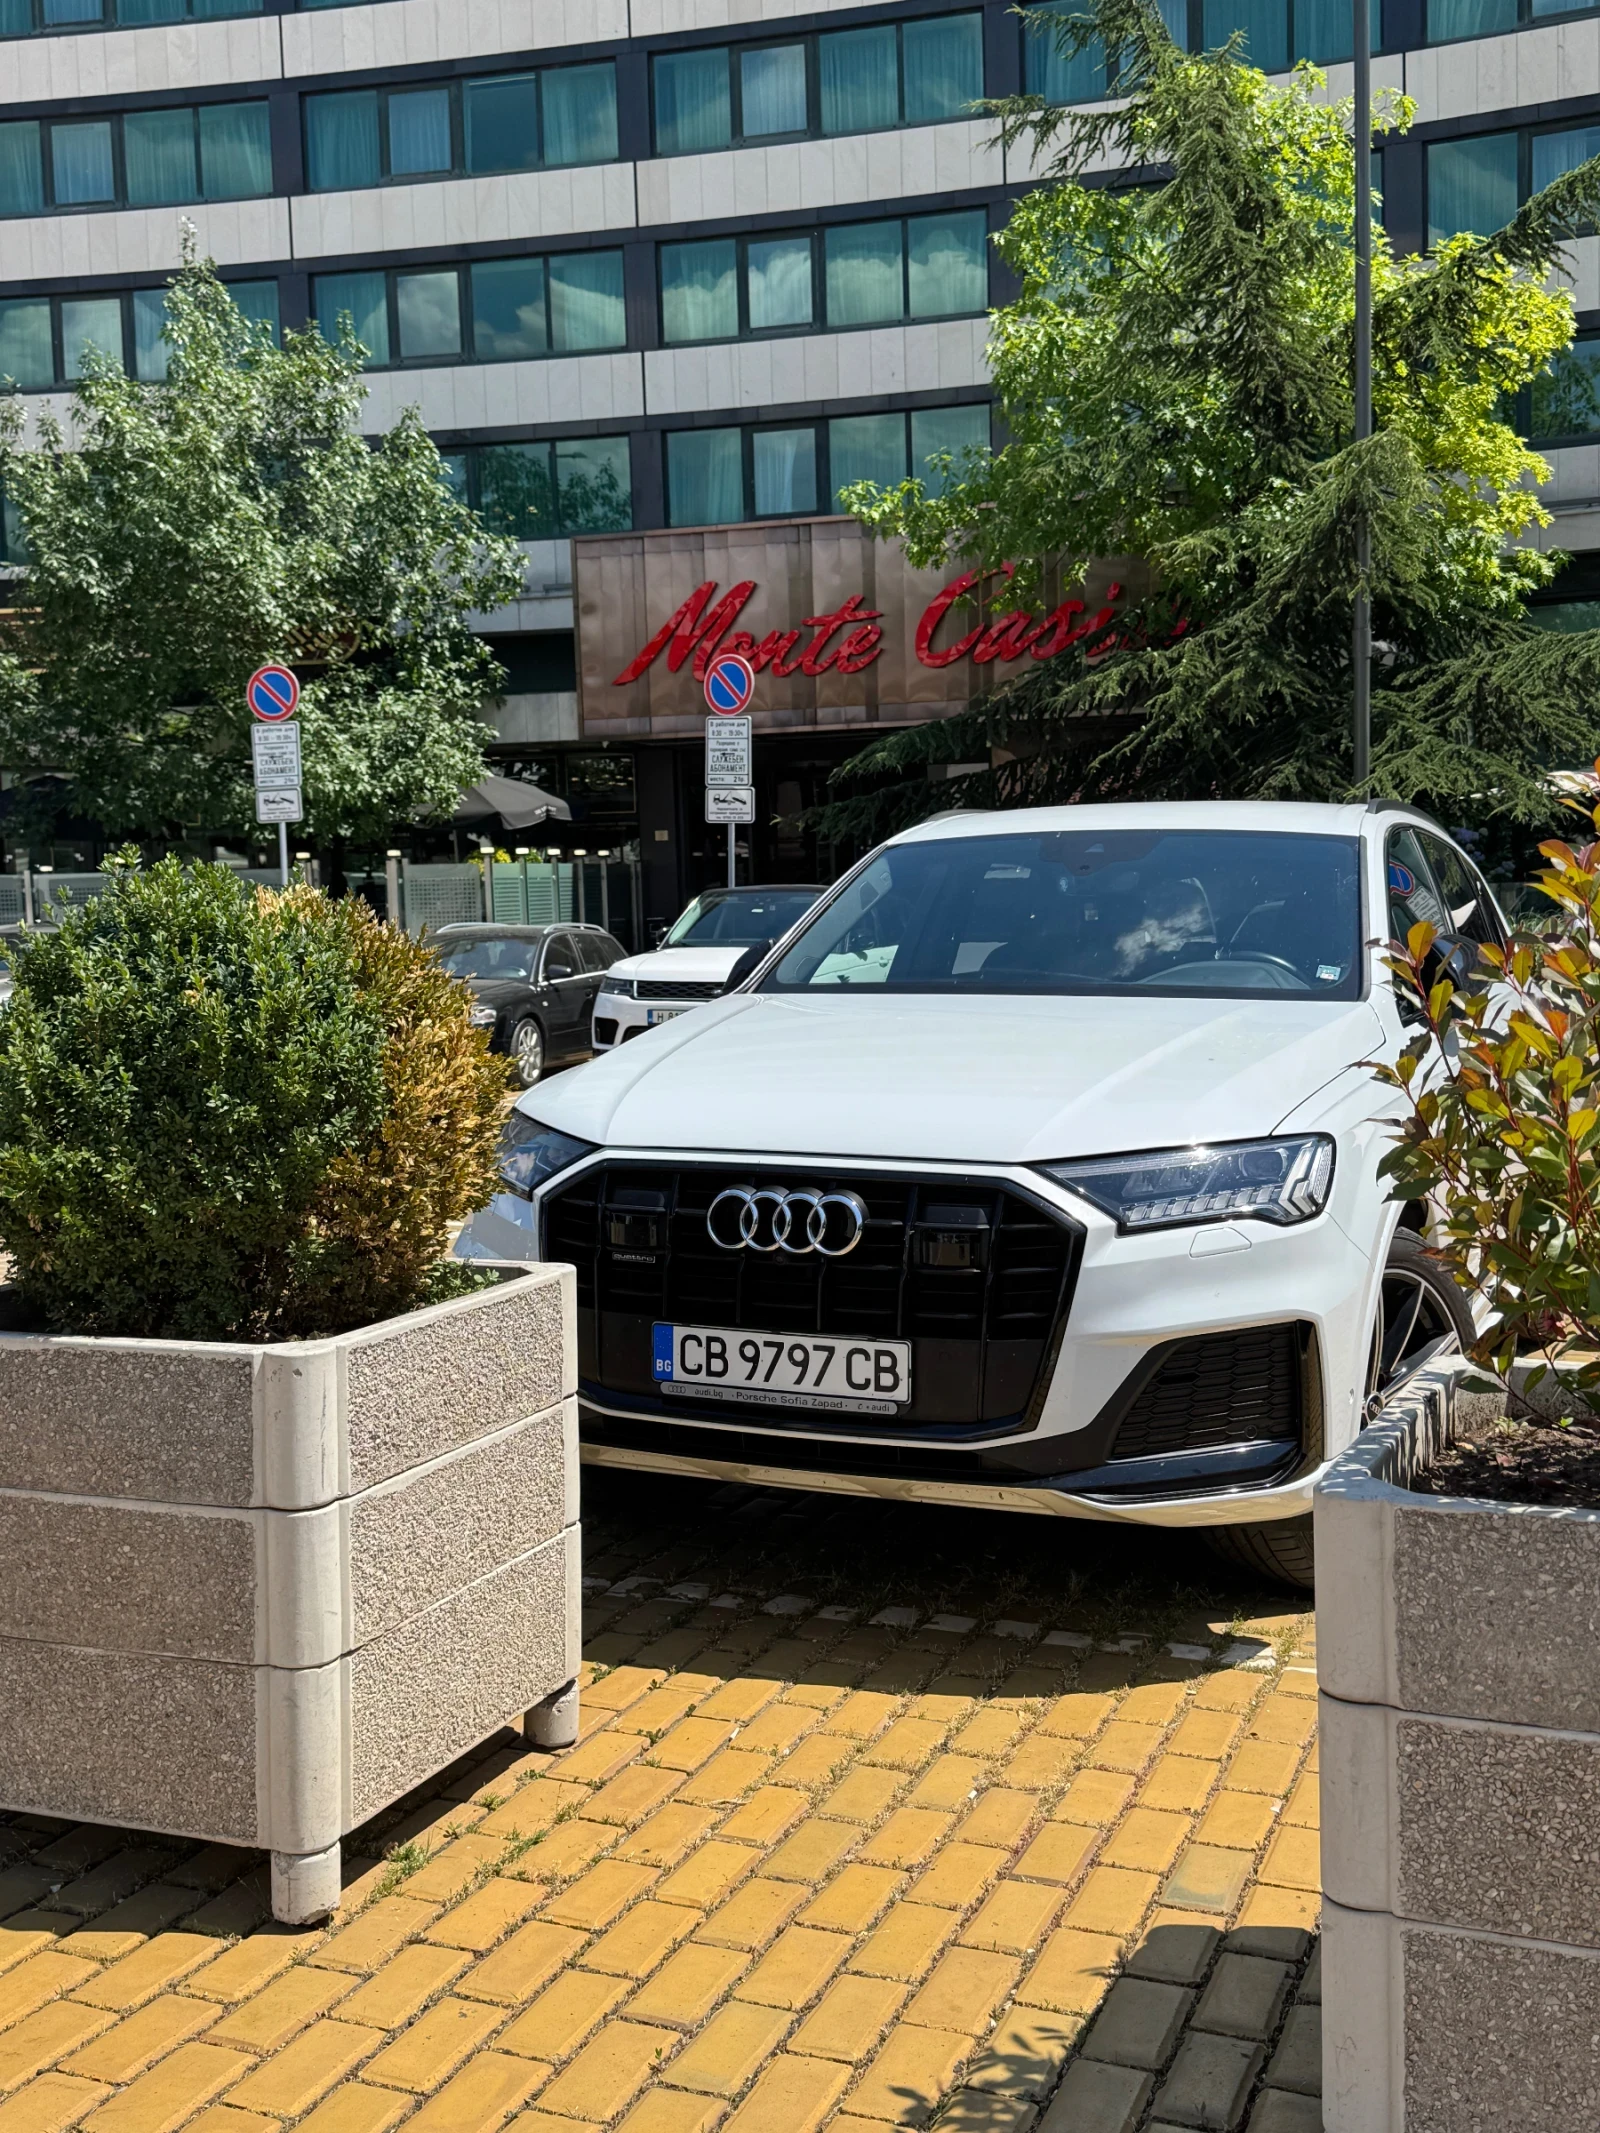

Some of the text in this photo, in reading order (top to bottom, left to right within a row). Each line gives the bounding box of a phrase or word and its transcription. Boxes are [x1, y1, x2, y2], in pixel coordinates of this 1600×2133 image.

[612, 580, 883, 686] Monte
[712, 755, 744, 764] СЛУЖЕБЕН
[259, 765, 296, 775] АБОНАМЕНТ
[710, 764, 746, 773] АБОНАМЕНТ
[657, 1012, 664, 1022] H
[613, 1253, 654, 1262] quattro
[656, 1333, 901, 1392] BG CB 9797 CB
[694, 1388, 724, 1399] audi.bg
[736, 1391, 777, 1403] Porsche
[780, 1395, 808, 1405] Sofia
[811, 1397, 843, 1410] Zapad
